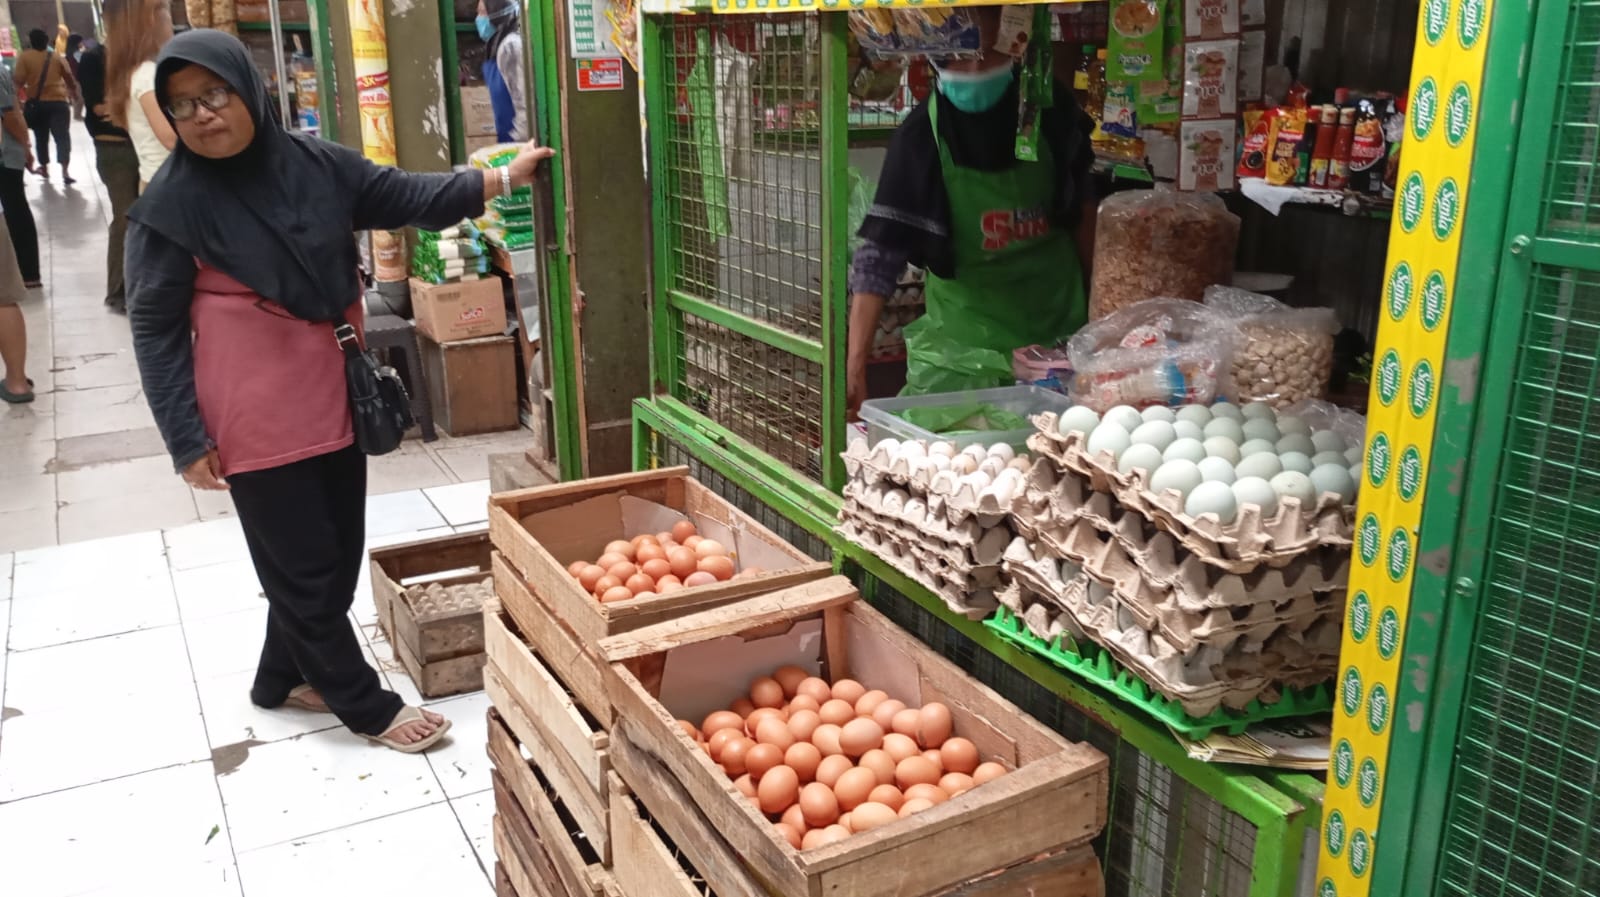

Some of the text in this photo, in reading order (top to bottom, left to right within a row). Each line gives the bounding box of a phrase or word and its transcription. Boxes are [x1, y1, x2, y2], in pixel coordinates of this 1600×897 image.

[1415, 89, 1434, 130] Sania
[1449, 94, 1468, 135] Sania
[1403, 183, 1421, 222] Sania
[1436, 190, 1455, 230] Sania
[1391, 273, 1409, 311] Sania
[1424, 282, 1442, 320] Sania
[1381, 360, 1398, 396] Sania
[1412, 370, 1430, 408] Sania
[1371, 443, 1387, 478] Sania
[1401, 456, 1418, 492] Sania
[1361, 523, 1377, 557] Sania
[1390, 538, 1407, 572] Sania
[1352, 601, 1368, 633] Sania
[1380, 617, 1396, 650] Sania
